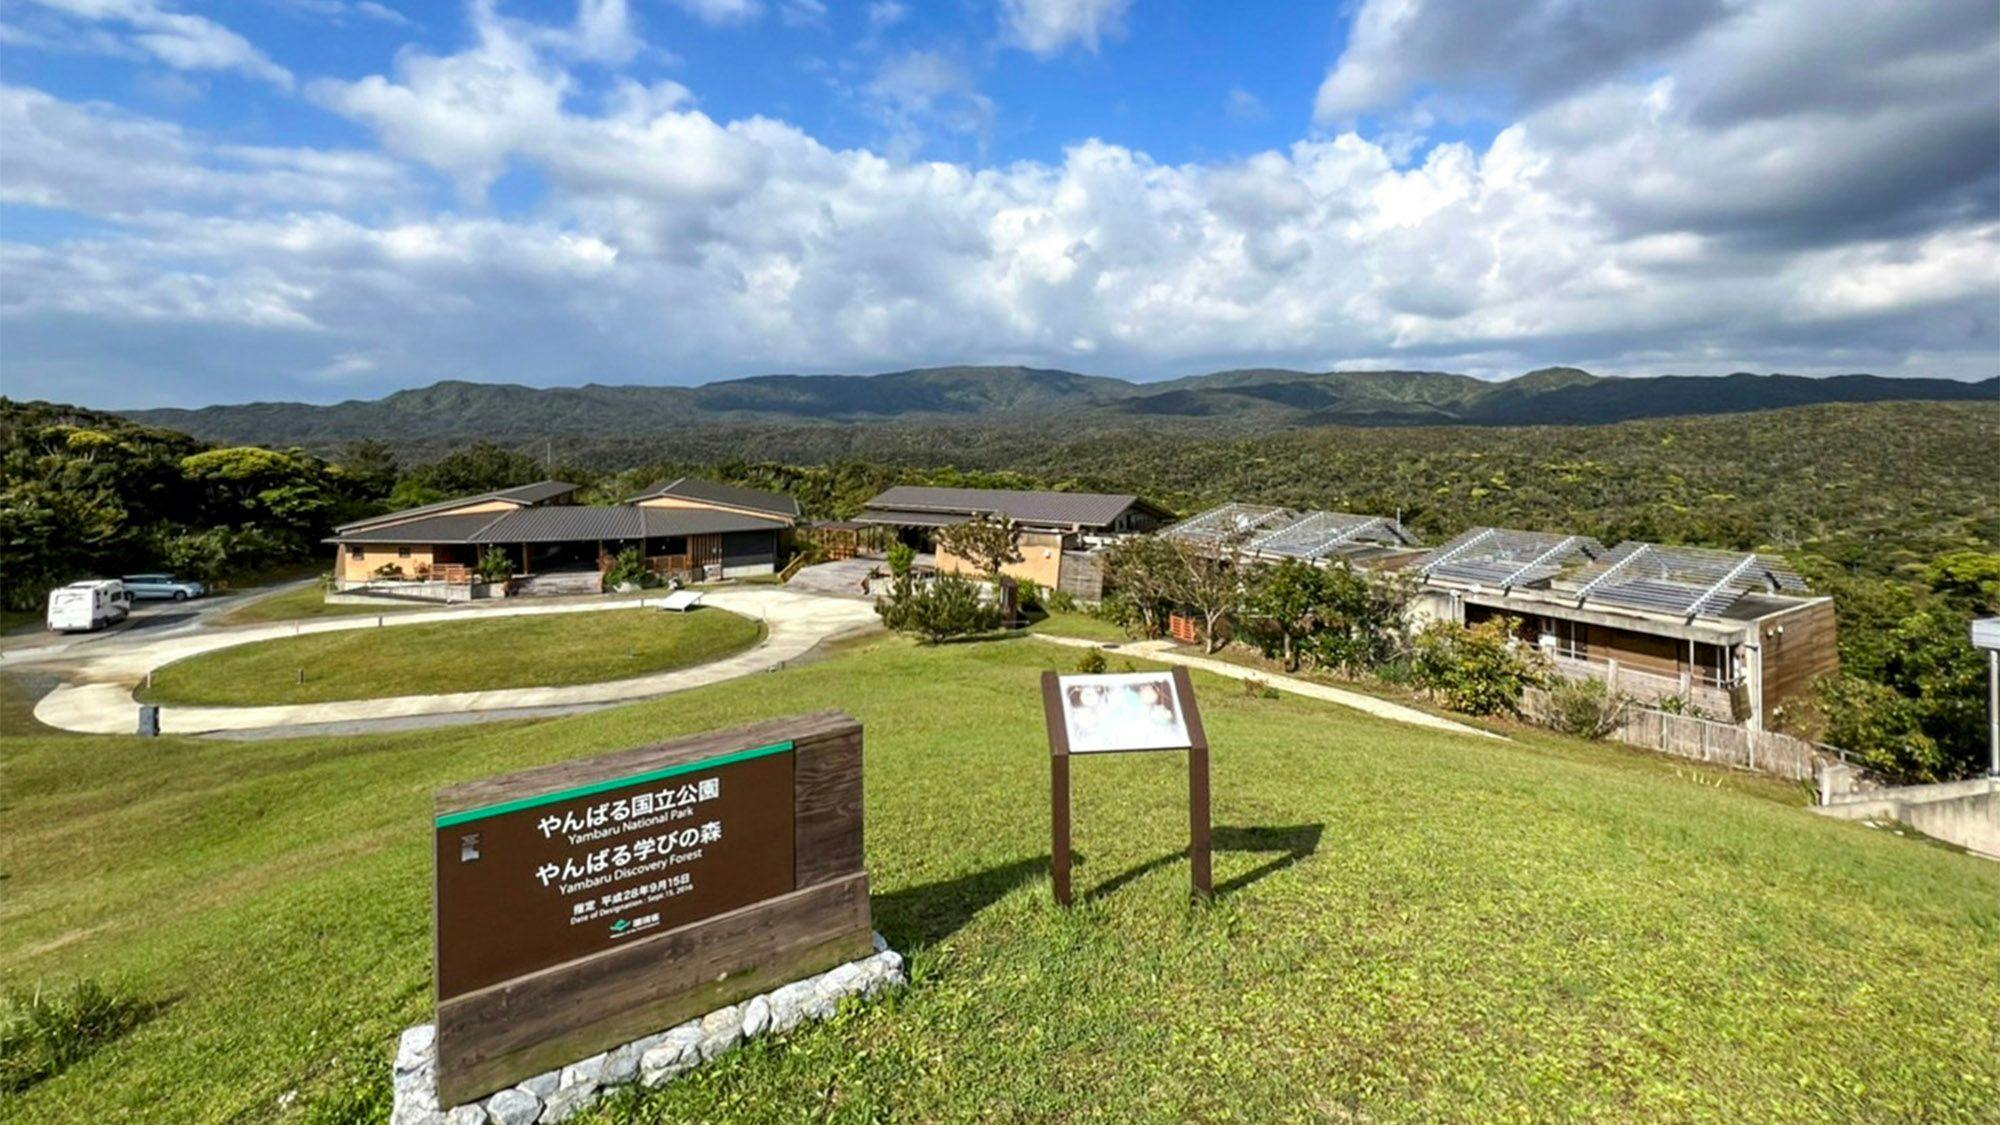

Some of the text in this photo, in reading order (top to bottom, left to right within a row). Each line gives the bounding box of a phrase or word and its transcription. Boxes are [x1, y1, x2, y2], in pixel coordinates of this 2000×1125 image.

[537, 777, 719, 838] やんばる国立公園
[568, 806, 694, 845] Yambaru National Park
[535, 820, 721, 886] やんばる学びの森
[559, 849, 702, 895] Yambaru Discovery Forest
[601, 873, 690, 906] 平成28年9月15日
[570, 913, 589, 925] Date
[590, 911, 599, 920] of
